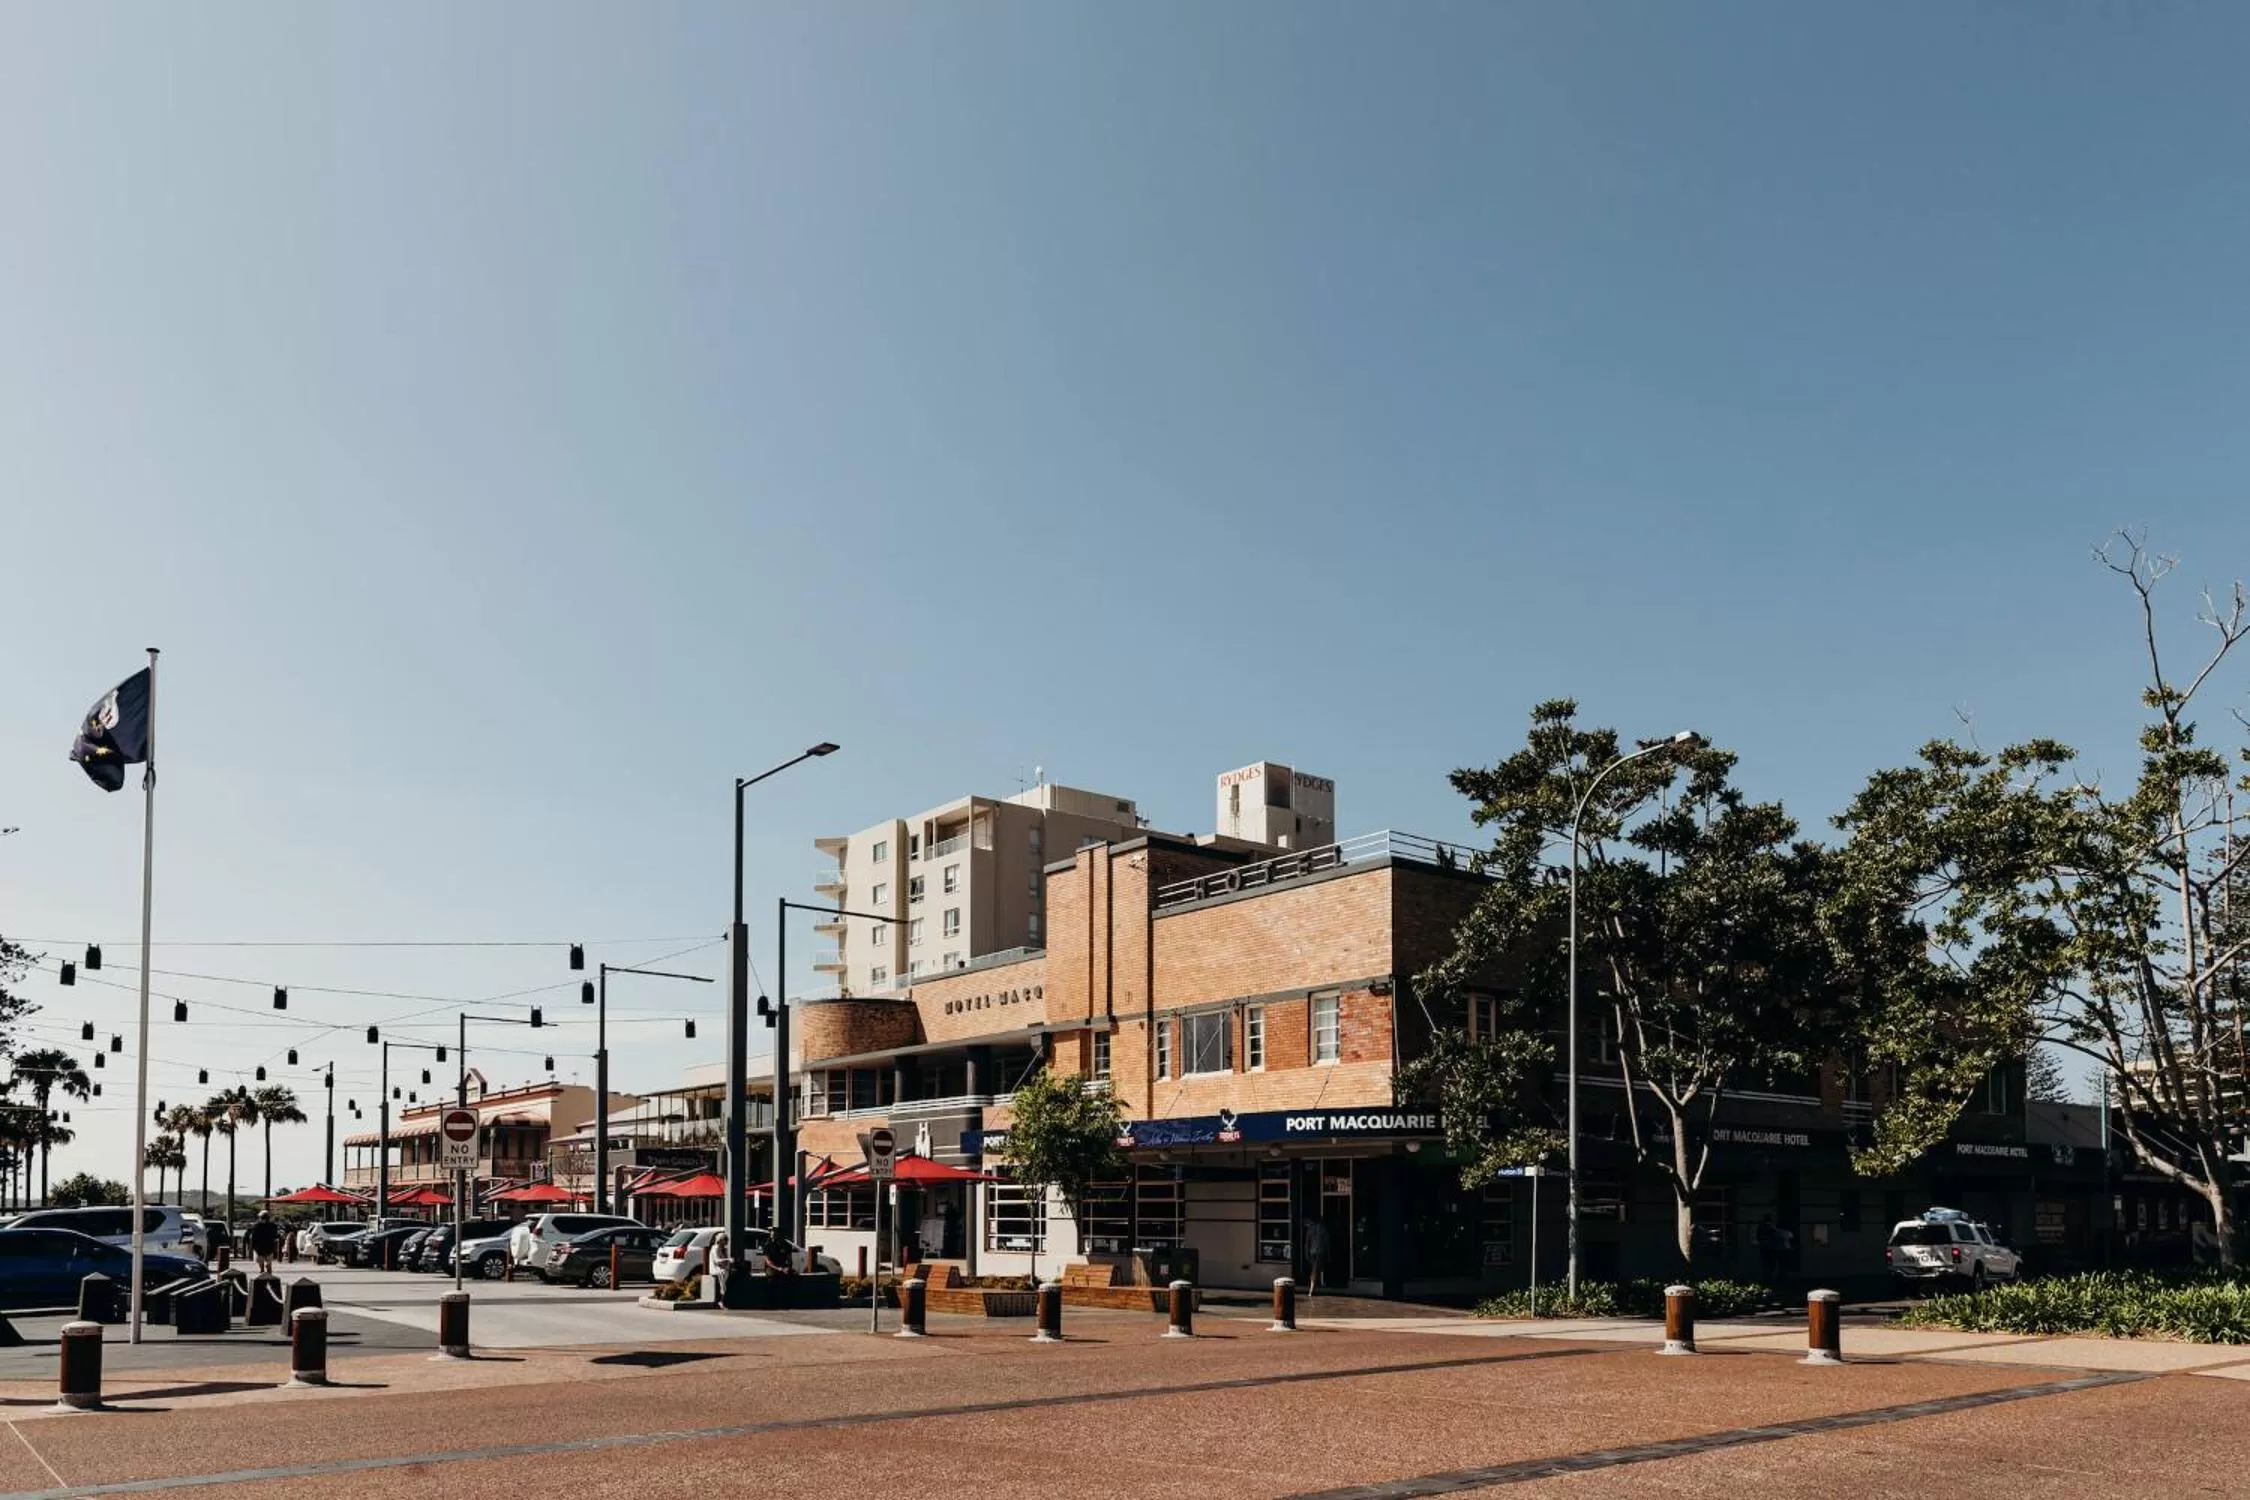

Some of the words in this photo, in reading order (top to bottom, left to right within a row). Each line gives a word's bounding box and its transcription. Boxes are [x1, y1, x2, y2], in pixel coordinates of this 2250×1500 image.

[1220, 767, 1261, 788] RYDGES
[1293, 773, 1332, 793] YDGES
[945, 994, 991, 1015] HOTEL
[1286, 1116, 1325, 1131] PORT
[1329, 1114, 1436, 1131] MACQUARIE
[1441, 1114, 1491, 1130] HEL
[1712, 1129, 1731, 1142] ORT
[1733, 1131, 1783, 1145] MACQUARIE
[1784, 1133, 1811, 1147] HOTEL
[451, 1143, 469, 1154] NO
[444, 1155, 475, 1165] ENTRY
[877, 1158, 889, 1167] NO
